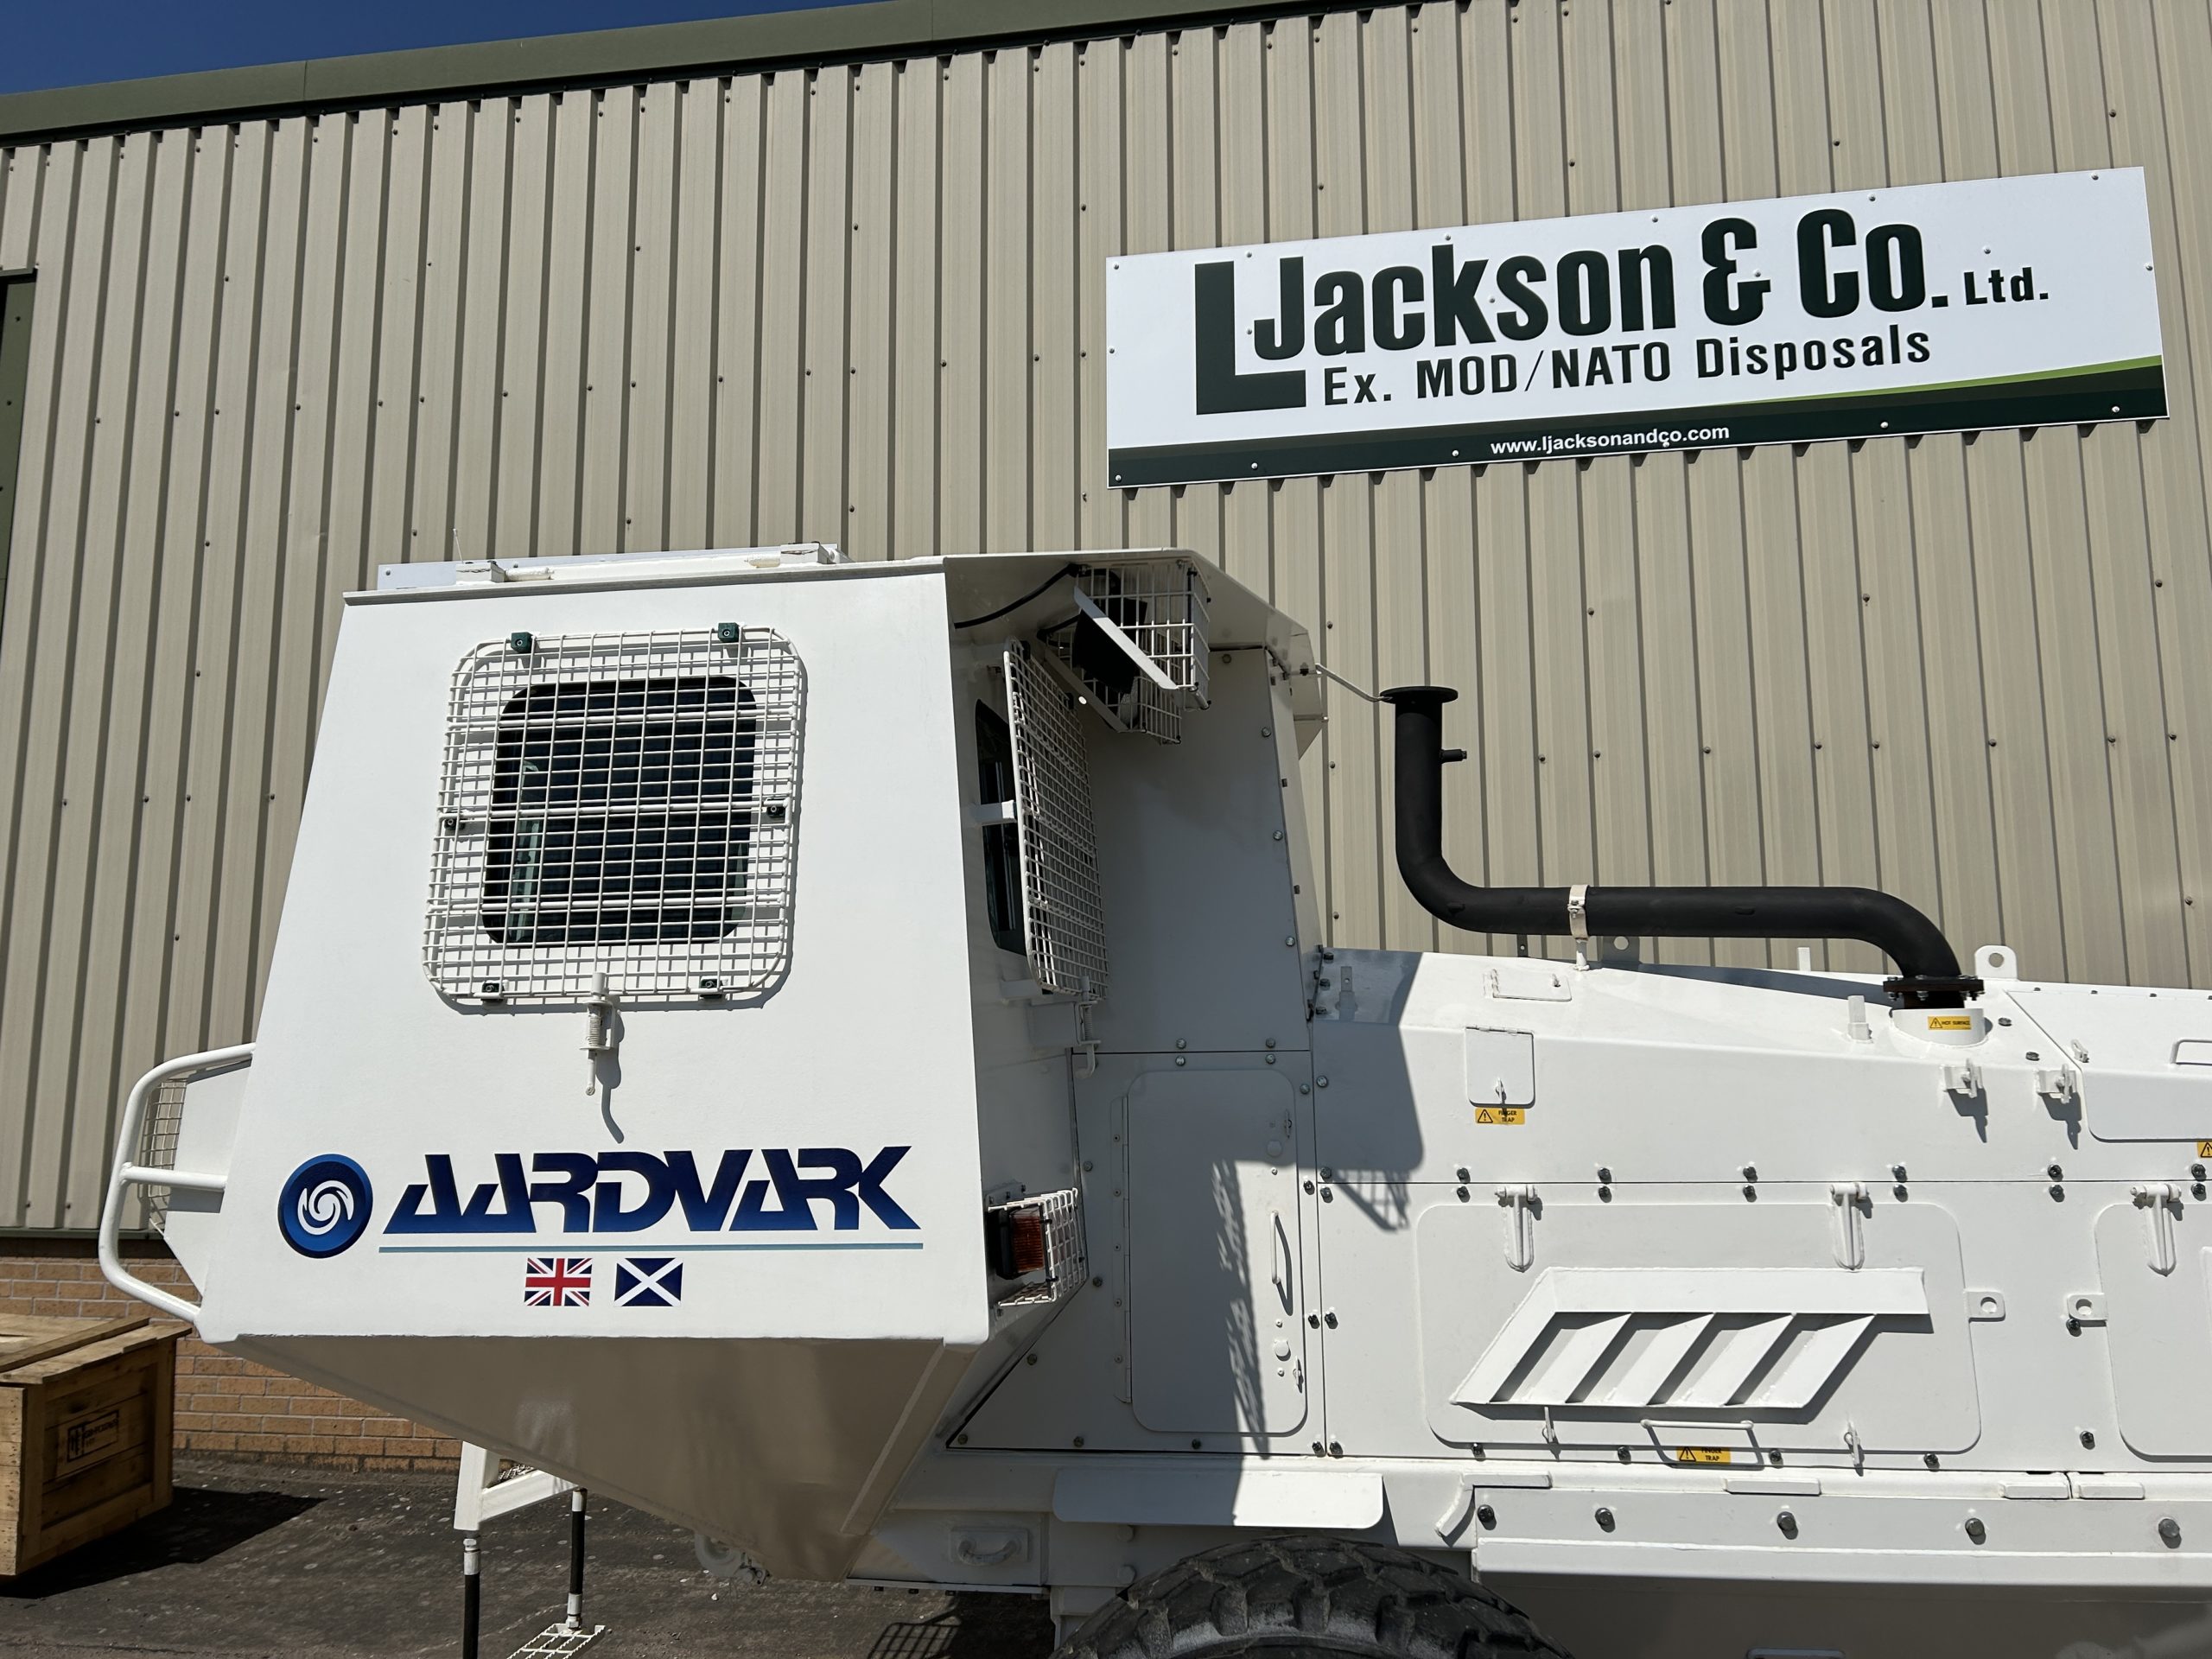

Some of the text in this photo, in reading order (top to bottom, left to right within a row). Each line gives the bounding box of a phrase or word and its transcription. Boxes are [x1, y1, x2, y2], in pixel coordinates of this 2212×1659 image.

[1700, 217, 1771, 327] &
[1796, 208, 1949, 319] Co.
[1963, 266, 2050, 306] Ltd.
[1324, 324, 1931, 406] Ex. MOD/NATO Disposals
[383, 1146, 922, 1235] AARDVARK
